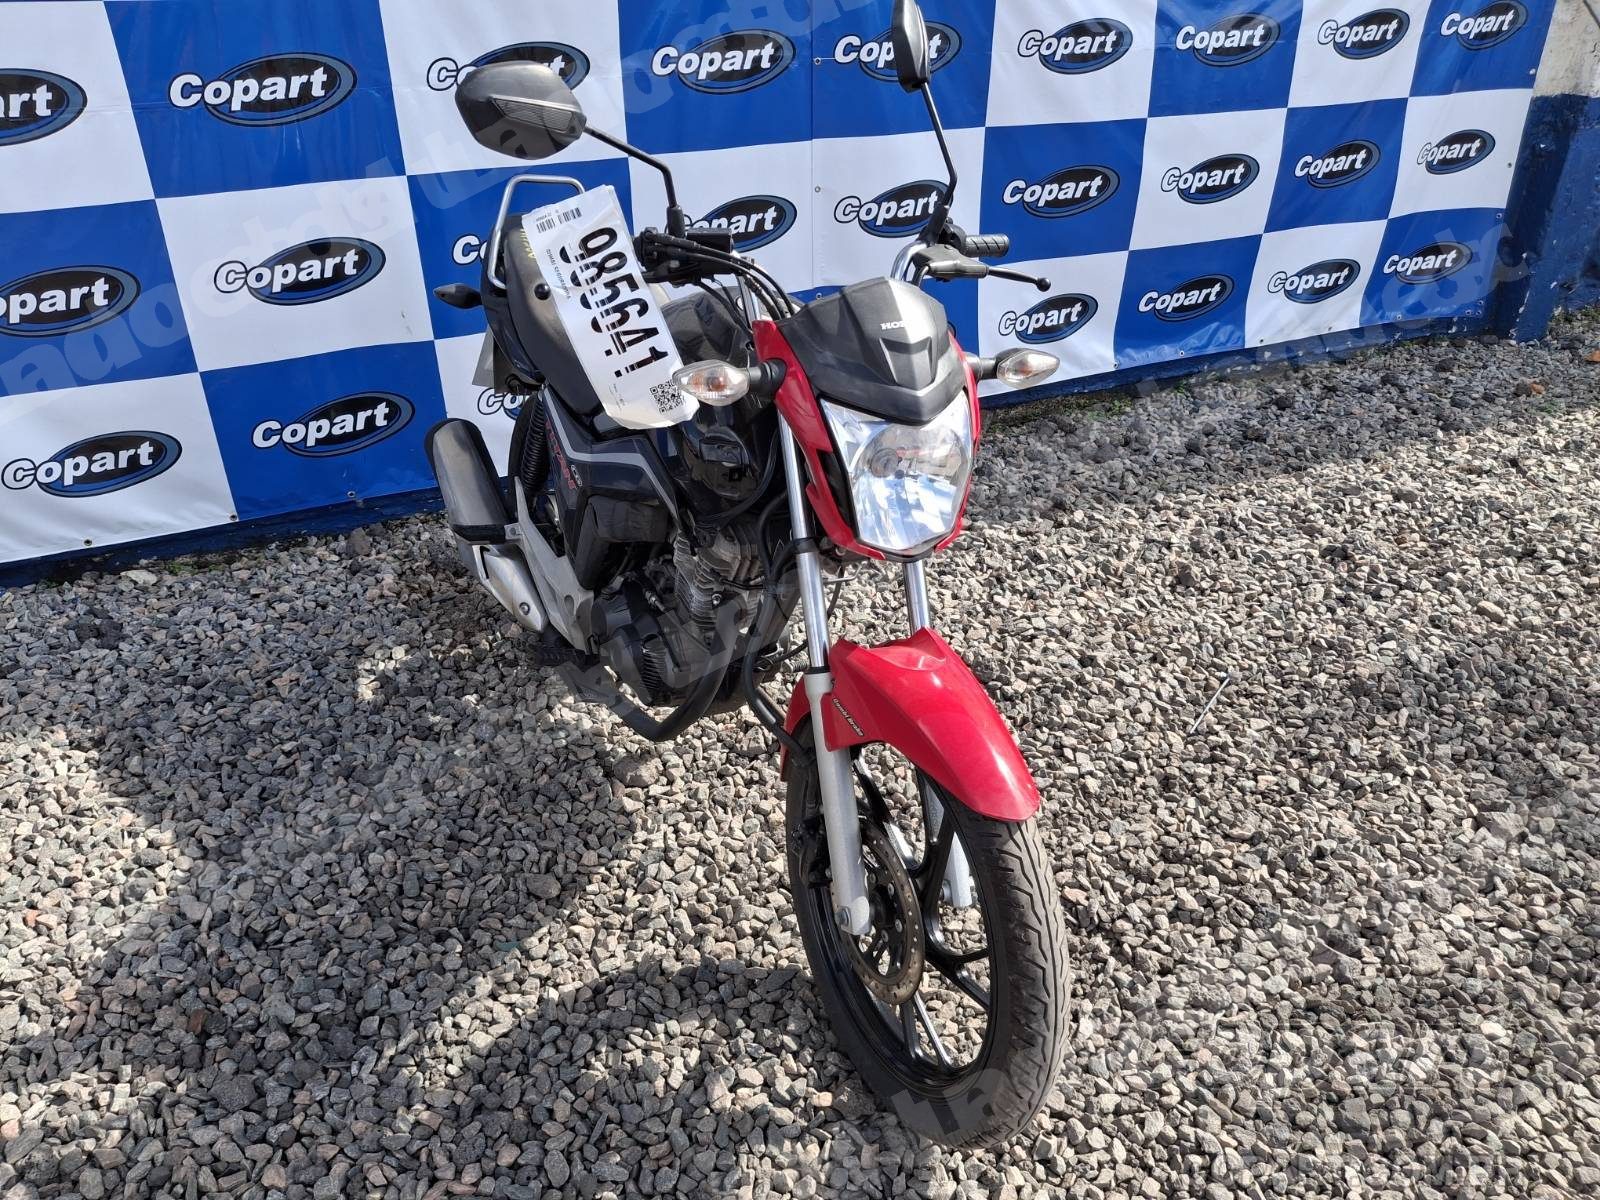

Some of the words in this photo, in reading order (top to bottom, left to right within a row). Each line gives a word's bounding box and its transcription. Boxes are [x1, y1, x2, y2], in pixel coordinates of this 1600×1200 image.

[1176, 22, 1266, 55] Copart
[1318, 17, 1399, 46] Copart
[1441, 10, 1514, 38] Copart
[834, 34, 942, 68] Copt
[1018, 30, 1117, 58] Copart
[652, 42, 774, 80] Copart
[0, 84, 53, 118] rt
[169, 66, 329, 111] Copart
[1295, 148, 1367, 178] Copart
[1417, 138, 1482, 166] Copart
[1003, 177, 1104, 205] Copart
[1161, 163, 1245, 193] Copart
[834, 191, 938, 226] Copart
[214, 248, 358, 293] Copart
[1383, 250, 1458, 275] Copart
[1138, 284, 1221, 312] Copart
[1268, 268, 1352, 297] Copart
[560, 227, 669, 378] 985641
[999, 302, 1082, 335] Copart
[252, 402, 390, 449] Copart
[2, 441, 154, 489] Copart
